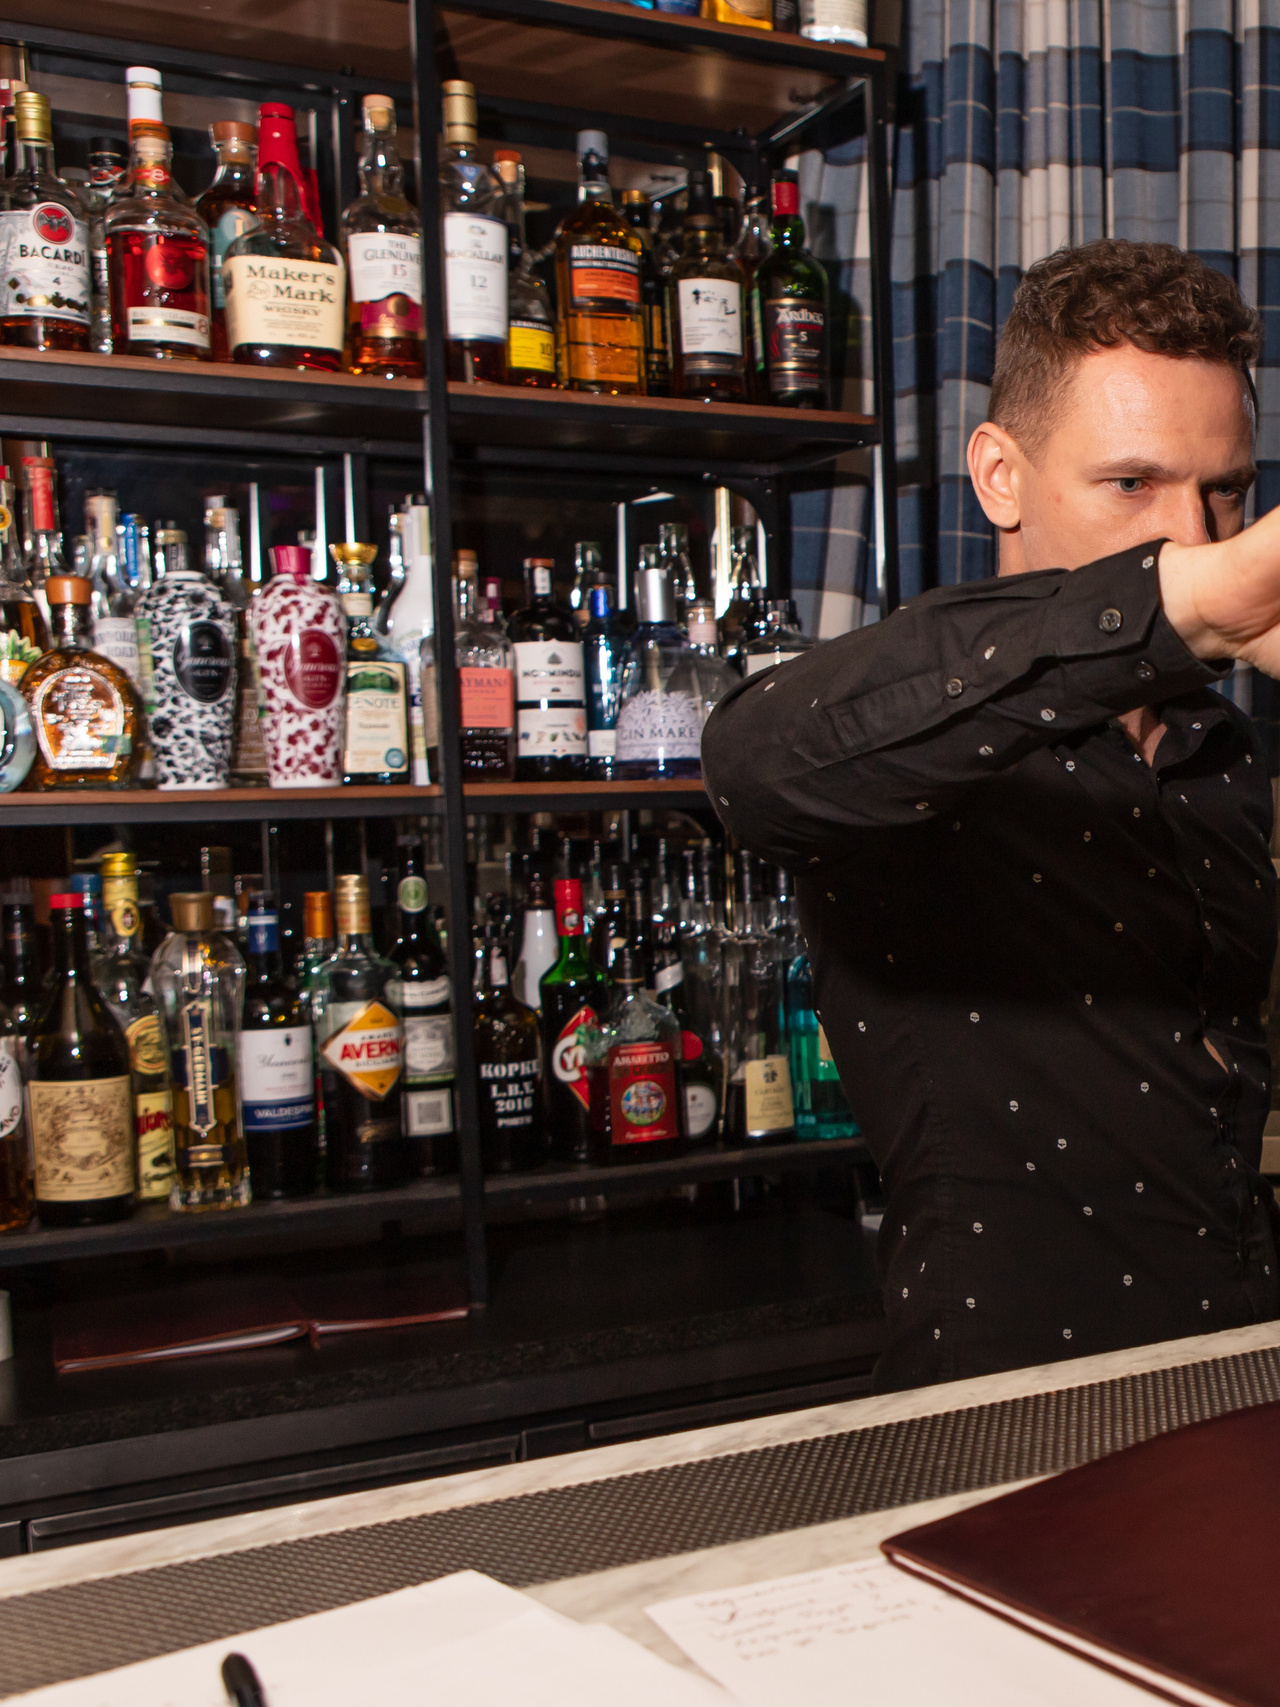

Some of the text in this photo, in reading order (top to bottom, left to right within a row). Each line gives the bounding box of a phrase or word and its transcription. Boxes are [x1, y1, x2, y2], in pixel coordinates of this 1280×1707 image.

[388, 240, 407, 250] THE
[363, 248, 422, 265] GLENLIVE
[246, 264, 336, 285] Maker's
[392, 264, 408, 277] 15
[470, 274, 488, 288] 12
[272, 283, 336, 304] Mark
[264, 305, 322, 316] WHISKY
[540, 343, 553, 356] 10
[620, 726, 696, 740] GIN MARE
[340, 1037, 400, 1062] AVERN
[495, 1097, 533, 1113] 2016
